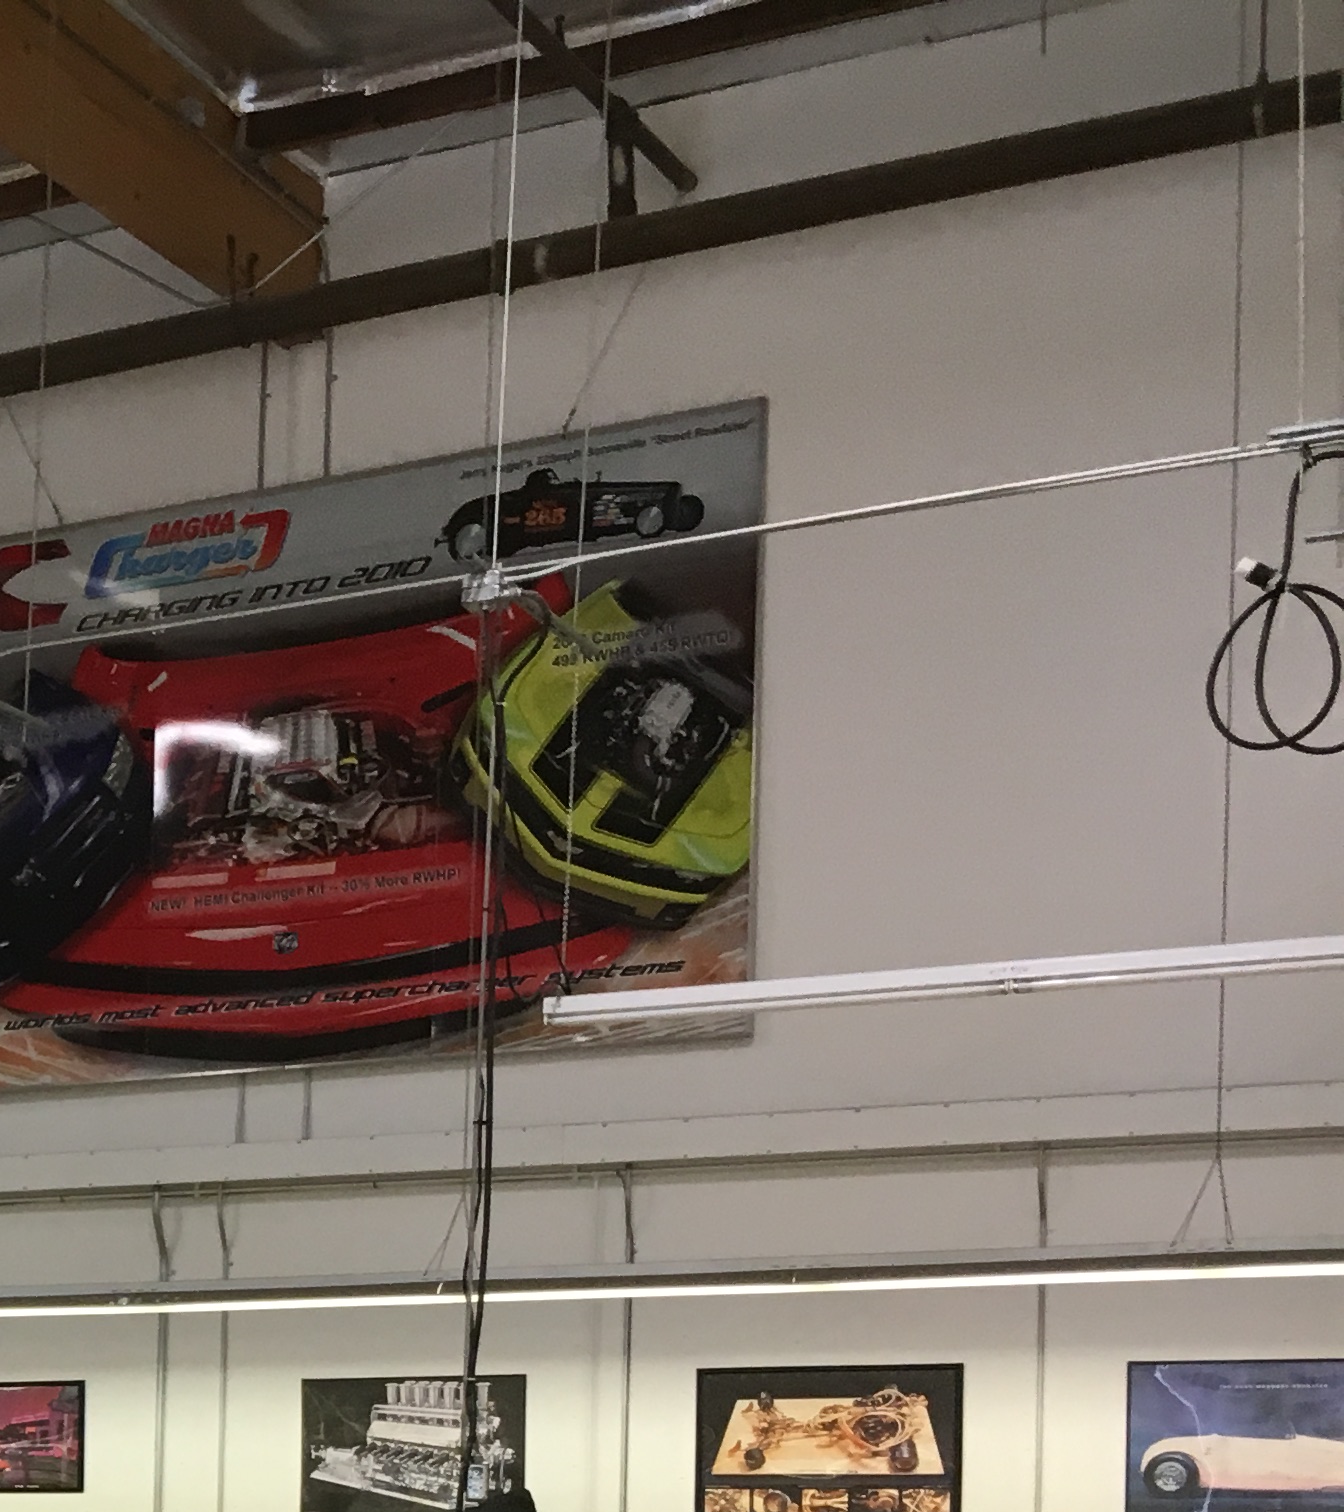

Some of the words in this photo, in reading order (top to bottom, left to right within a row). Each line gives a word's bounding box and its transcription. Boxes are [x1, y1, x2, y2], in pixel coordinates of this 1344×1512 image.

[146, 511, 236, 547] MAGNA
[77, 590, 241, 632] CHARGING
[251, 575, 331, 602] INTO
[337, 556, 432, 588] 2010
[231, 887, 304, 906] Challenger
[375, 875, 409, 889] More
[4, 1010, 91, 1032] worlds
[98, 1003, 167, 1024] most
[173, 992, 315, 1017] advanced
[321, 972, 538, 1005] supercharger
[543, 959, 686, 986] systems
